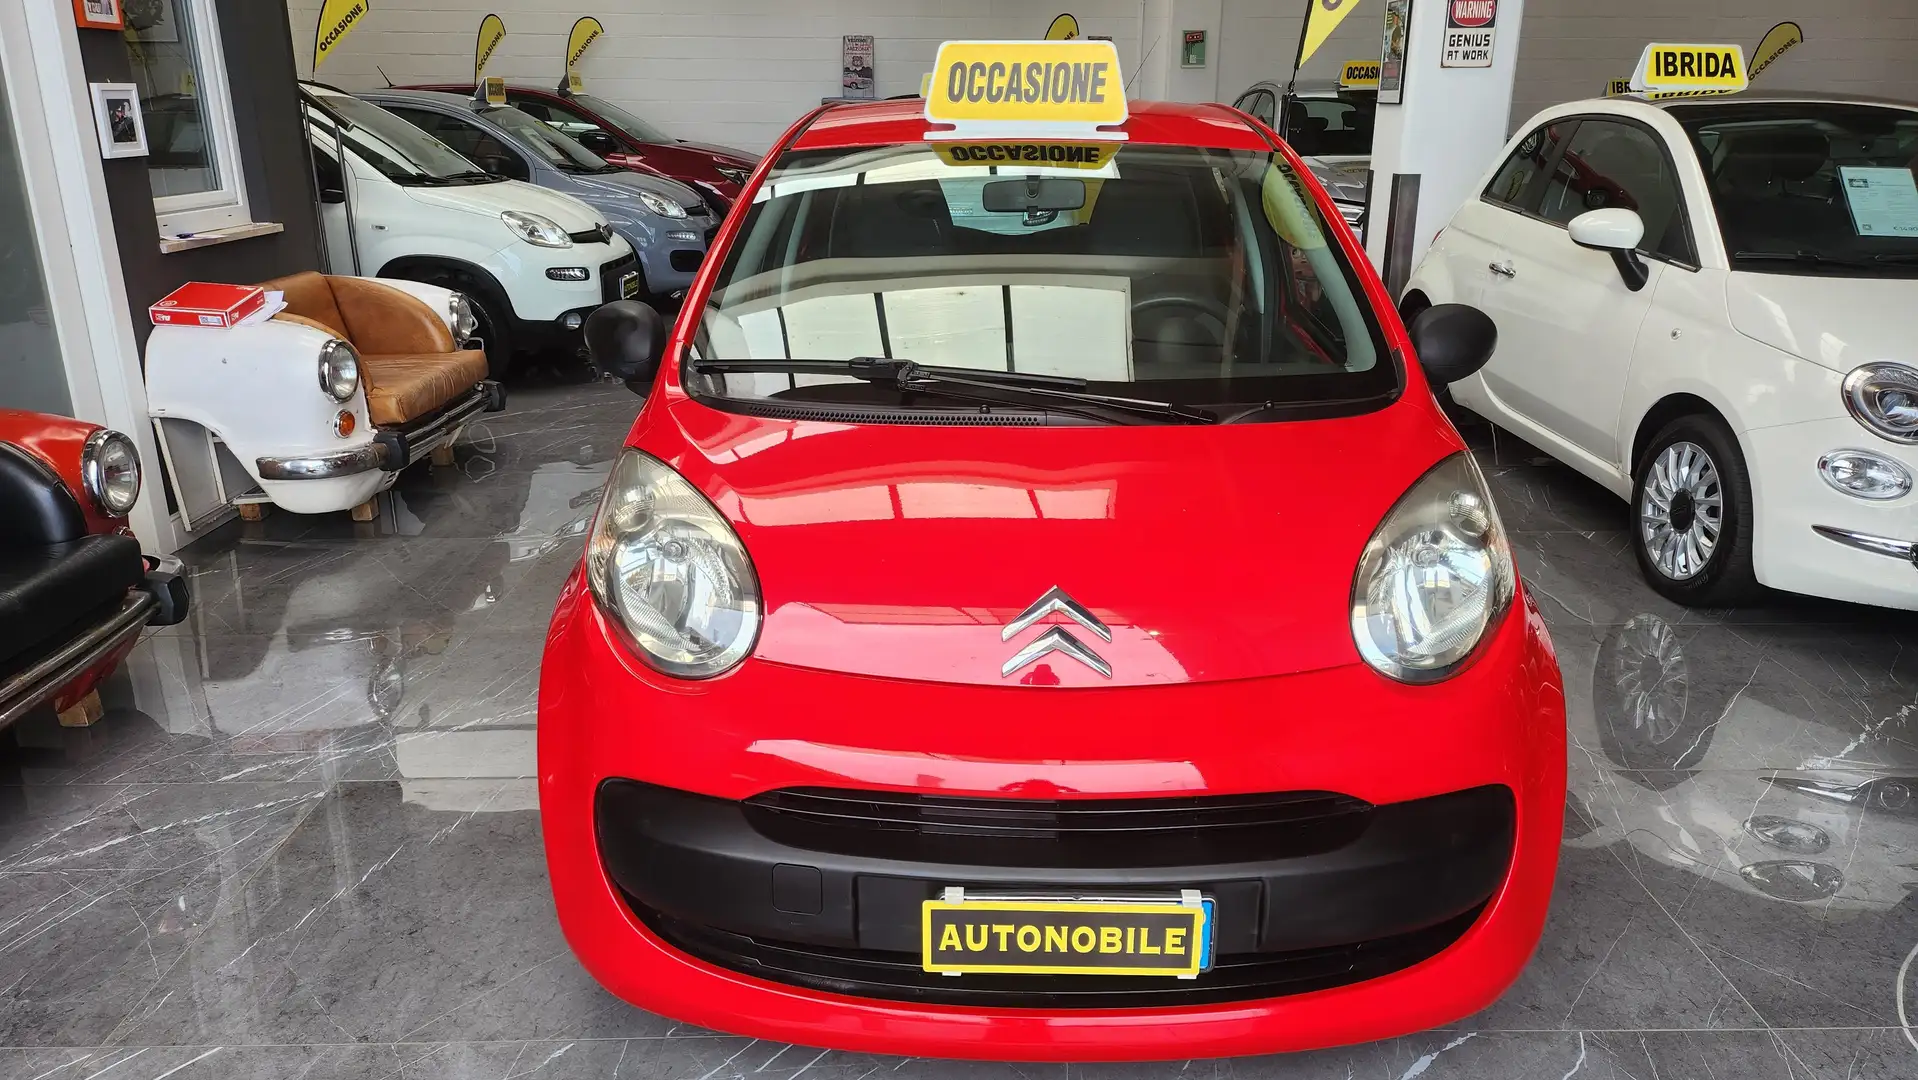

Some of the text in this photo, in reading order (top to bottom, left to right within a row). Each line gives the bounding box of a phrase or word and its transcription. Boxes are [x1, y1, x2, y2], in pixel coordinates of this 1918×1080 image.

[1455, 0, 1493, 19] WARNING
[320, 3, 363, 51] OCCASIONE
[1448, 34, 1491, 47] GENIUS
[477, 31, 503, 71] OCCASIONE
[569, 29, 599, 66] OCCASIONE
[1447, 50, 1489, 60] AT WORK
[1749, 37, 1798, 82] OCCASIONE
[1346, 66, 1380, 80] OCCASI
[1655, 51, 1736, 78] IBRIDA
[948, 61, 1109, 104] OCCASIONE
[939, 924, 1187, 956] AUTONOBILE
